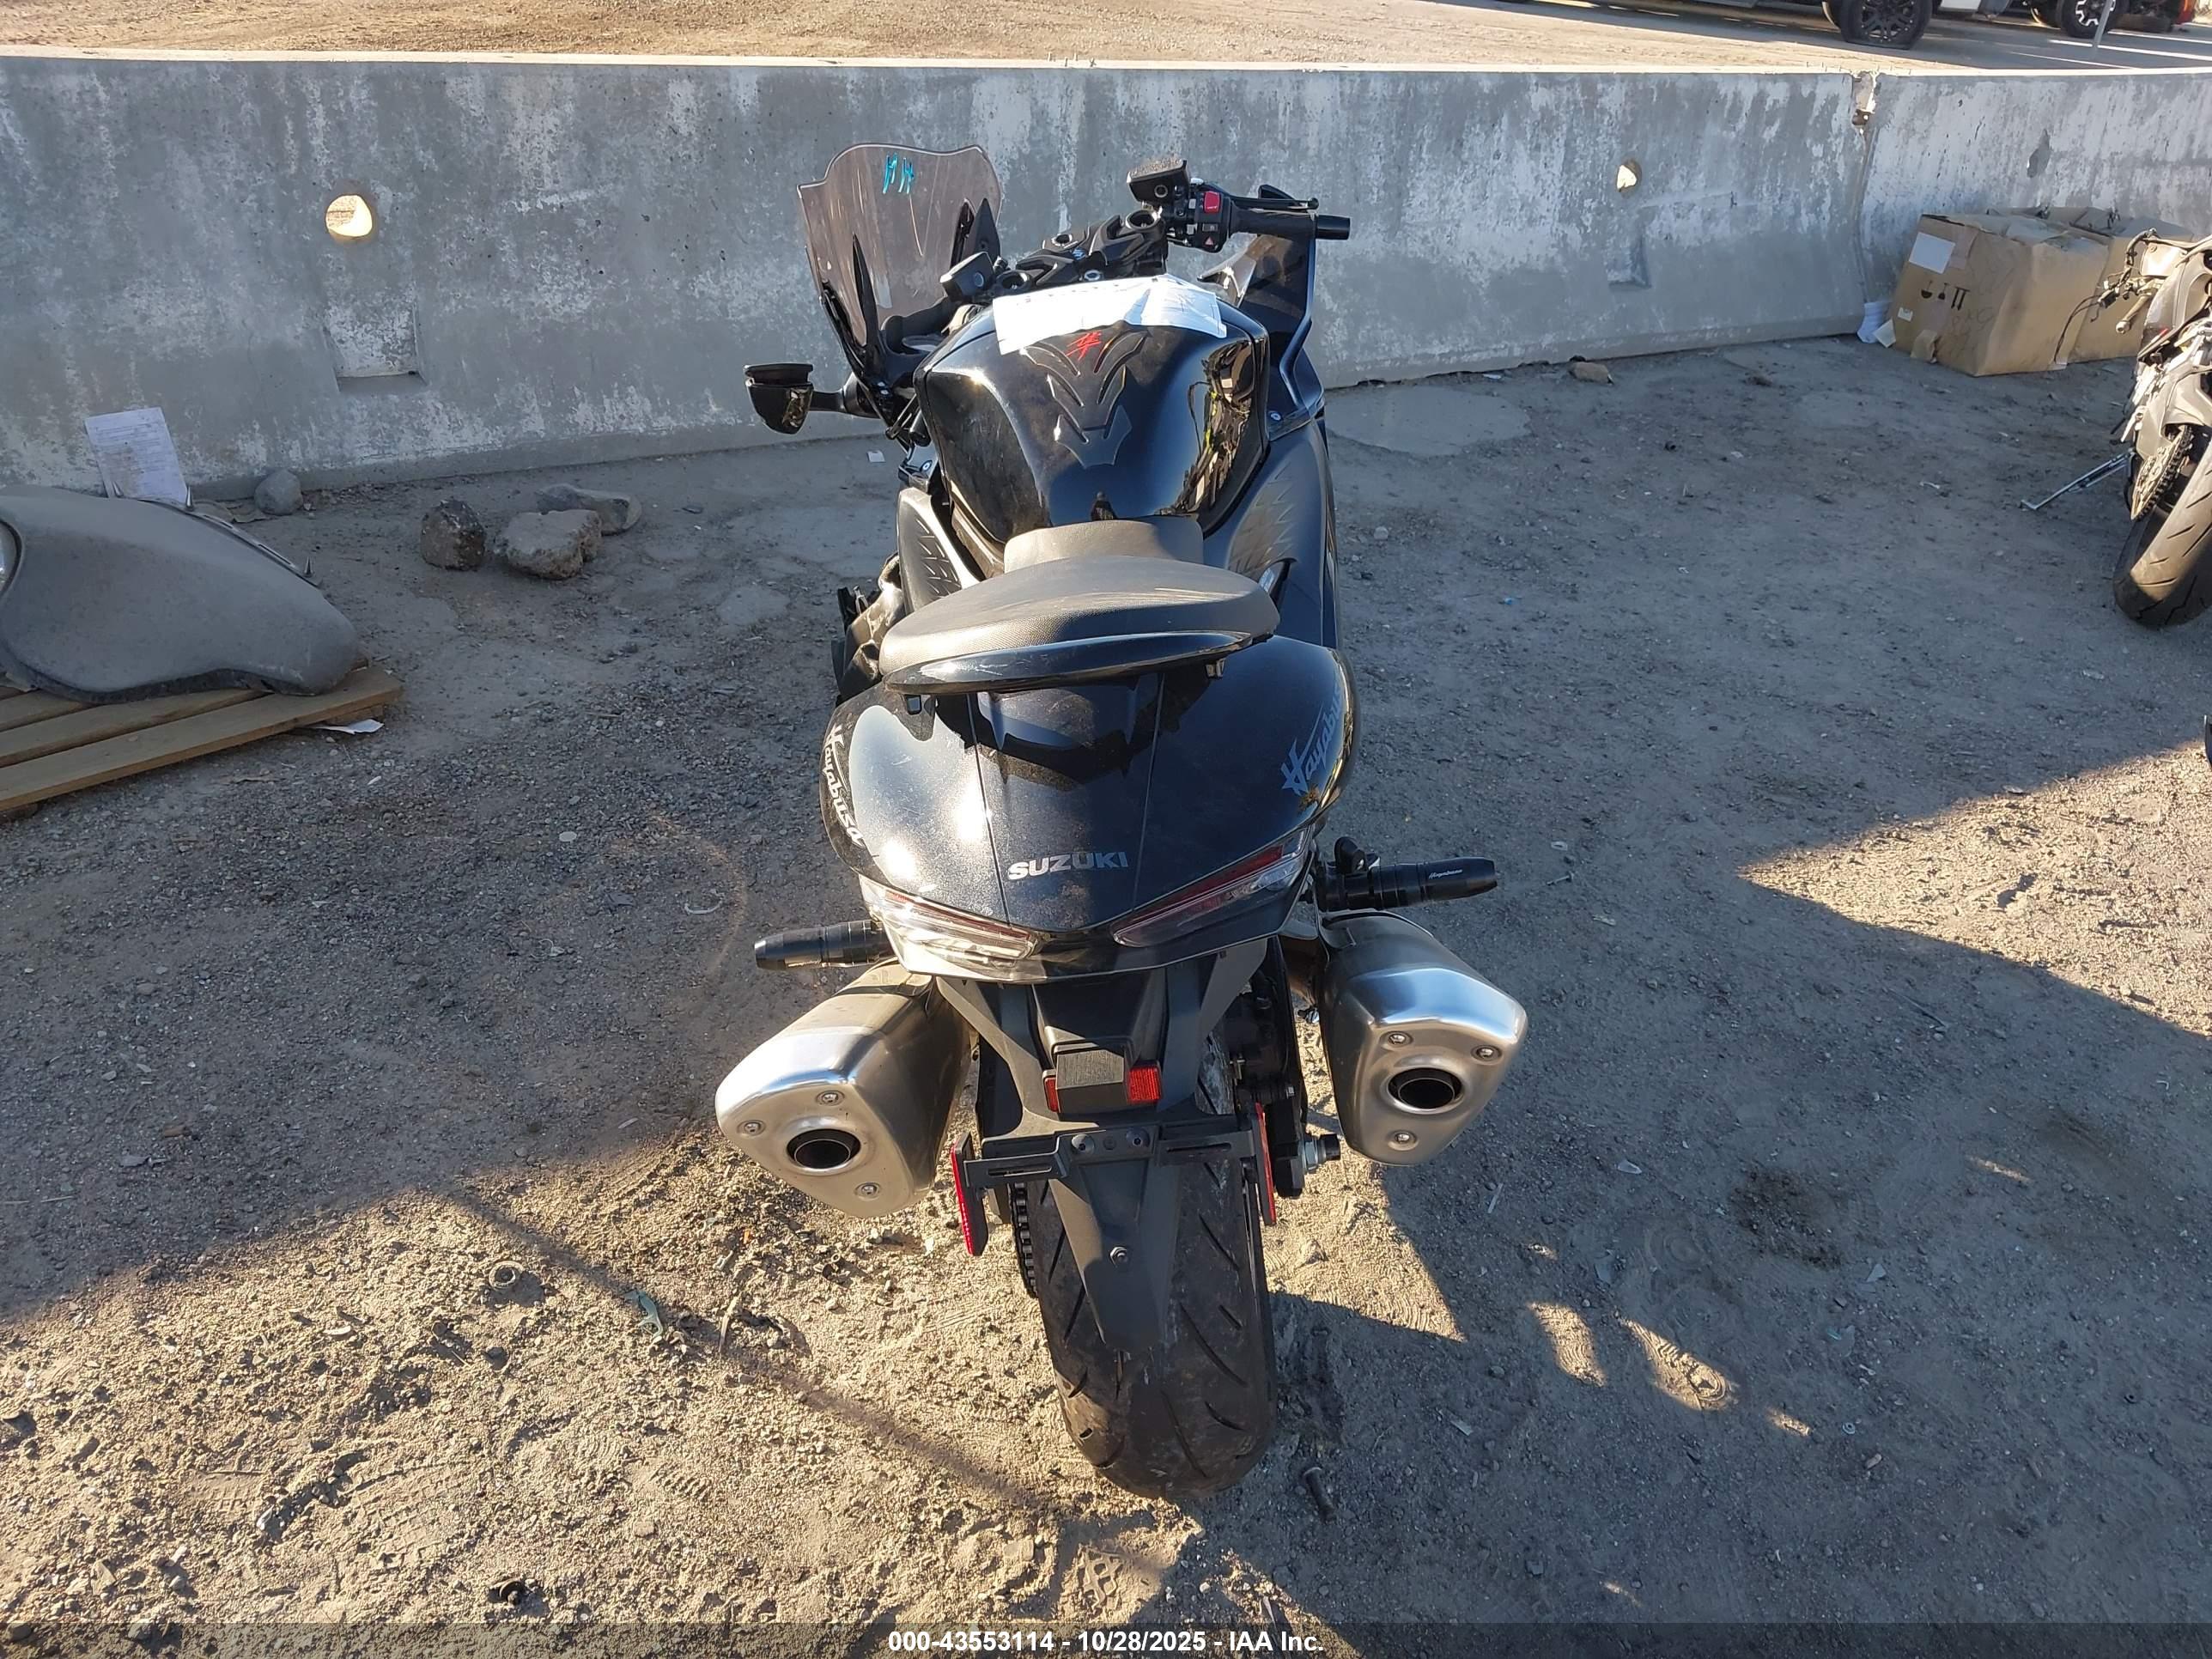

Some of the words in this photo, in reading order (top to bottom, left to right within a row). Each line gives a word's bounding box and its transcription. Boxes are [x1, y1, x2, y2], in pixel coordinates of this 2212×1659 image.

[821, 723, 866, 848] Hayabusa
[1280, 681, 1343, 797] Hayabus
[1007, 851, 1129, 880] SUZUKI
